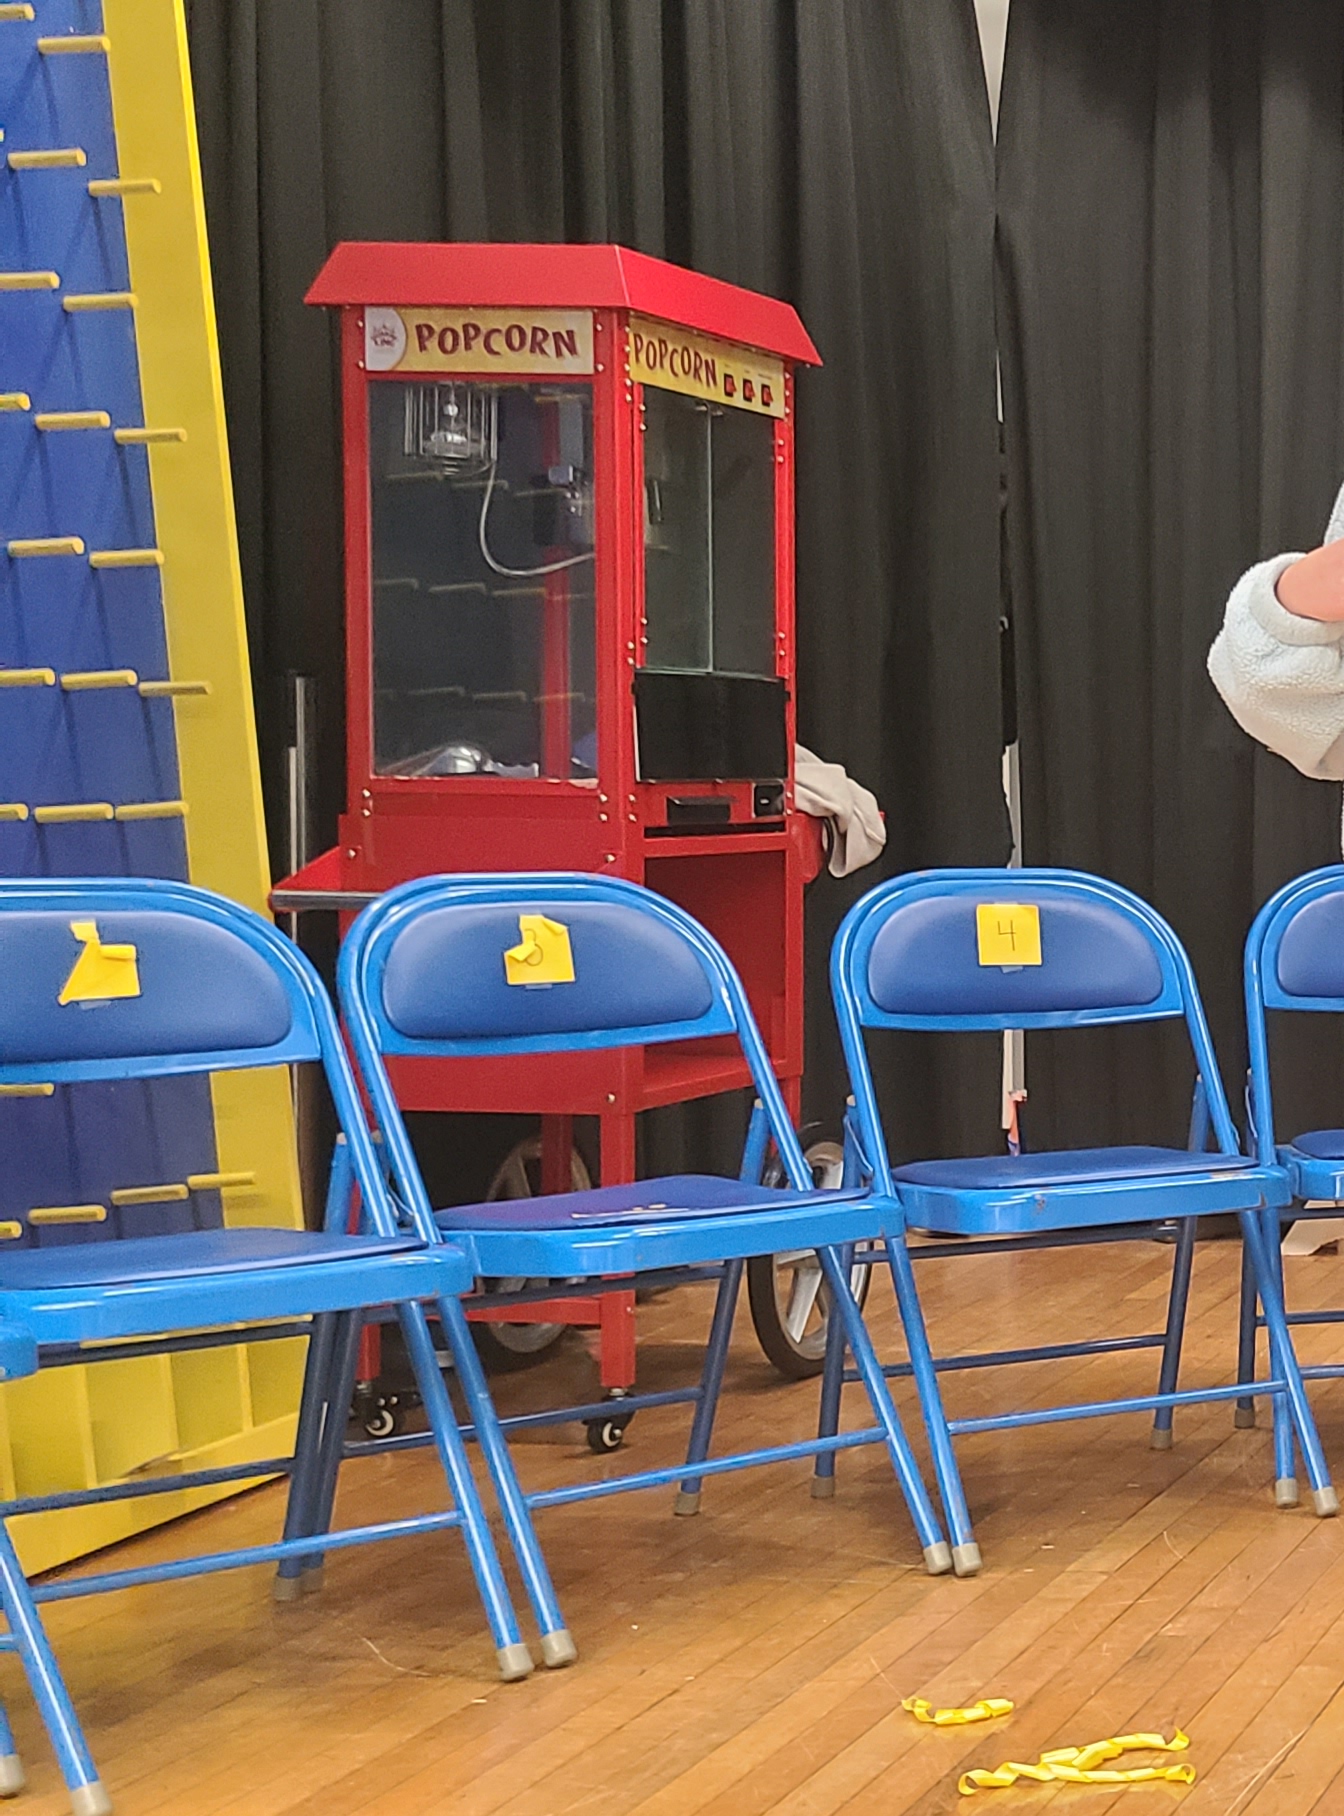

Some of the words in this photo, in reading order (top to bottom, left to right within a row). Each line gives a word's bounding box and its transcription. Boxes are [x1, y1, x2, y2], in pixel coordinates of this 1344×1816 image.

[415, 322, 579, 359] POPCORN
[633, 333, 718, 388] POPCORN
[997, 919, 1017, 952] 4
